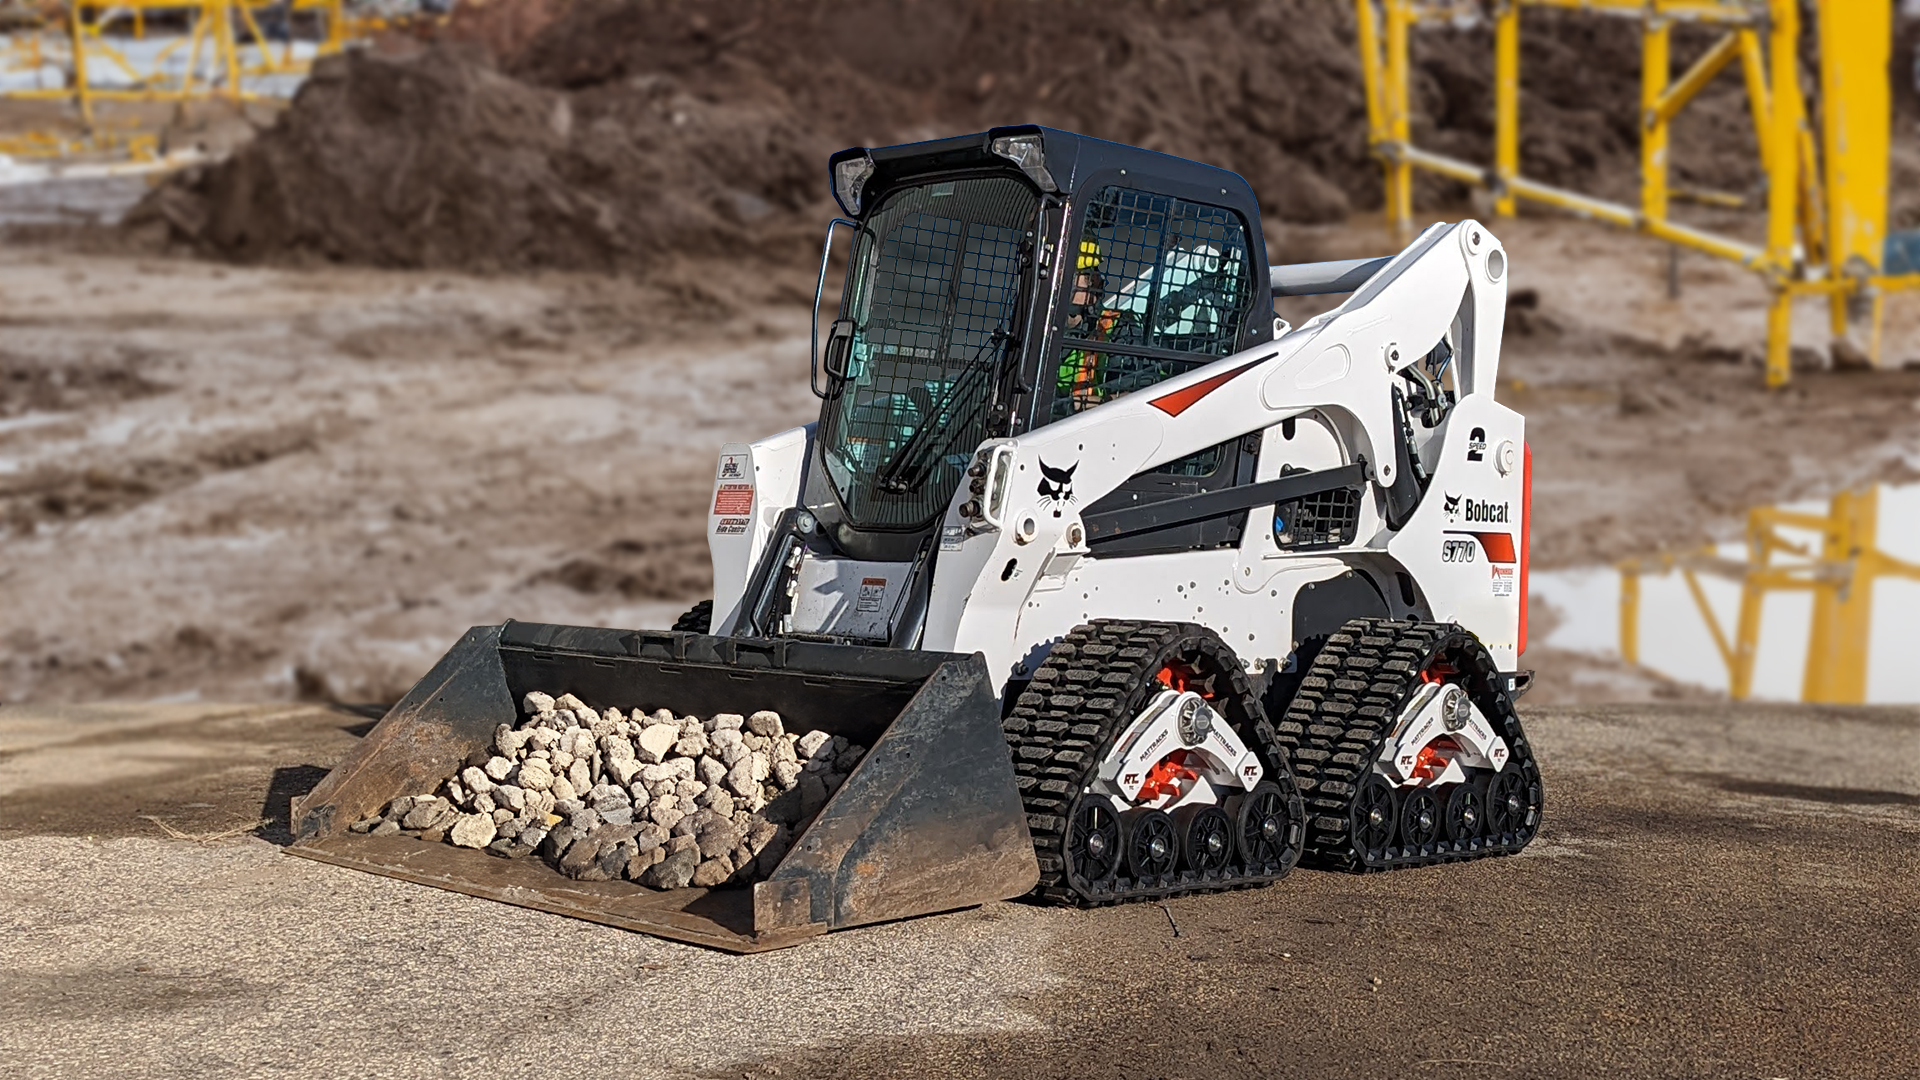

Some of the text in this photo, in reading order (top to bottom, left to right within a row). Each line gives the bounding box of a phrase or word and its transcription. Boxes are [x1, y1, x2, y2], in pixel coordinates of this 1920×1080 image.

[1467, 427, 1486, 462] 2
[1468, 442, 1487, 451] SPEED
[1465, 498, 1509, 523] Bobcat
[728, 525, 747, 533] Control
[1442, 540, 1476, 563] S770
[1411, 716, 1434, 746] MATTRACKS
[1468, 718, 1487, 741] ATTRACKS
[1139, 728, 1169, 762] MATTRACKS
